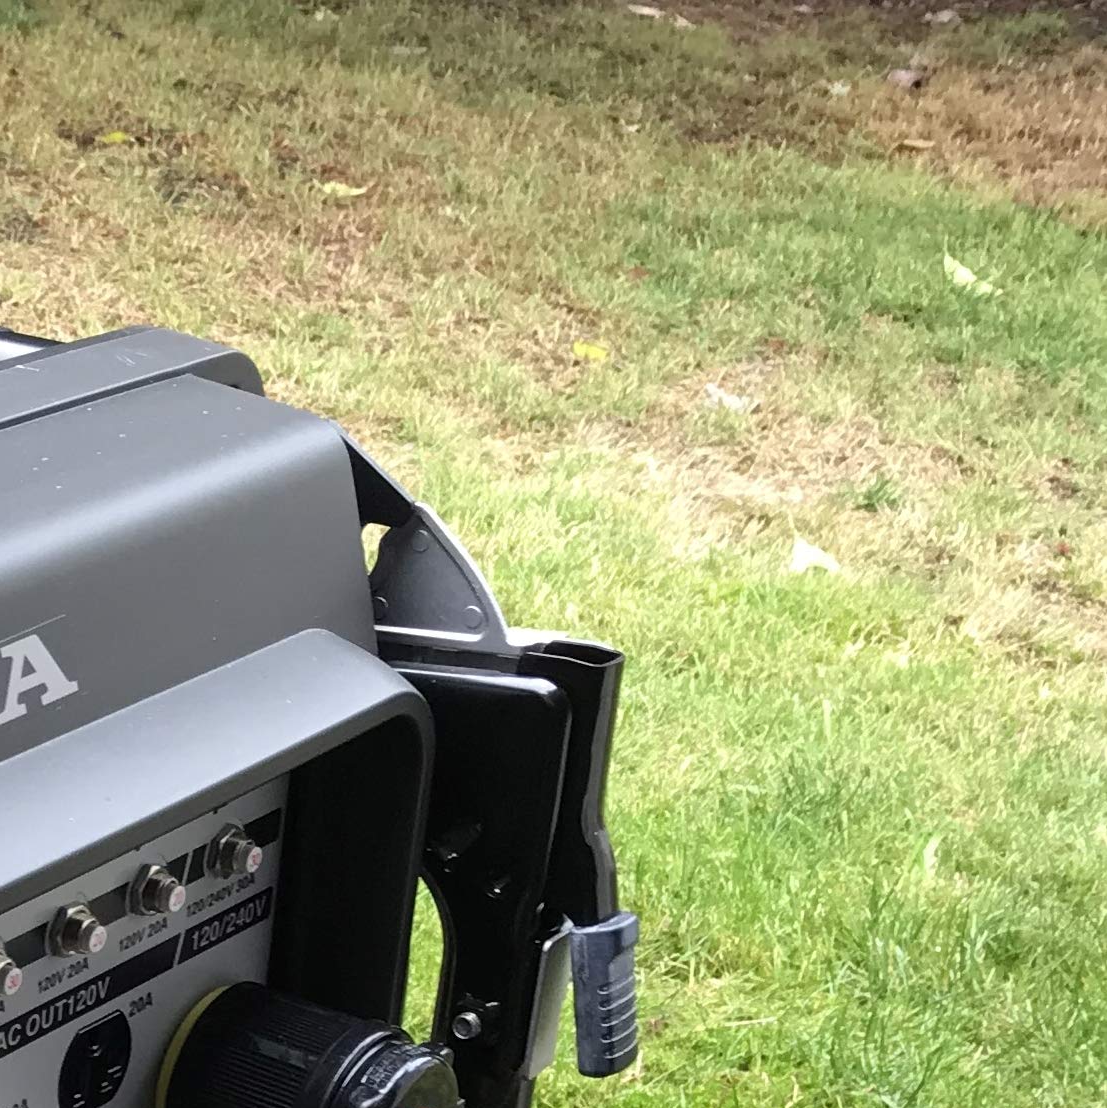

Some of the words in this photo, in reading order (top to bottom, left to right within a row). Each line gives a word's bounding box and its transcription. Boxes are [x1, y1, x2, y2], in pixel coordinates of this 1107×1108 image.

[118, 928, 145, 951] 120V
[147, 917, 168, 938] 20A
[191, 896, 267, 950] 120/240V
[38, 968, 65, 993] 120V
[67, 957, 89, 978] 20A
[128, 992, 153, 1018] 20A
